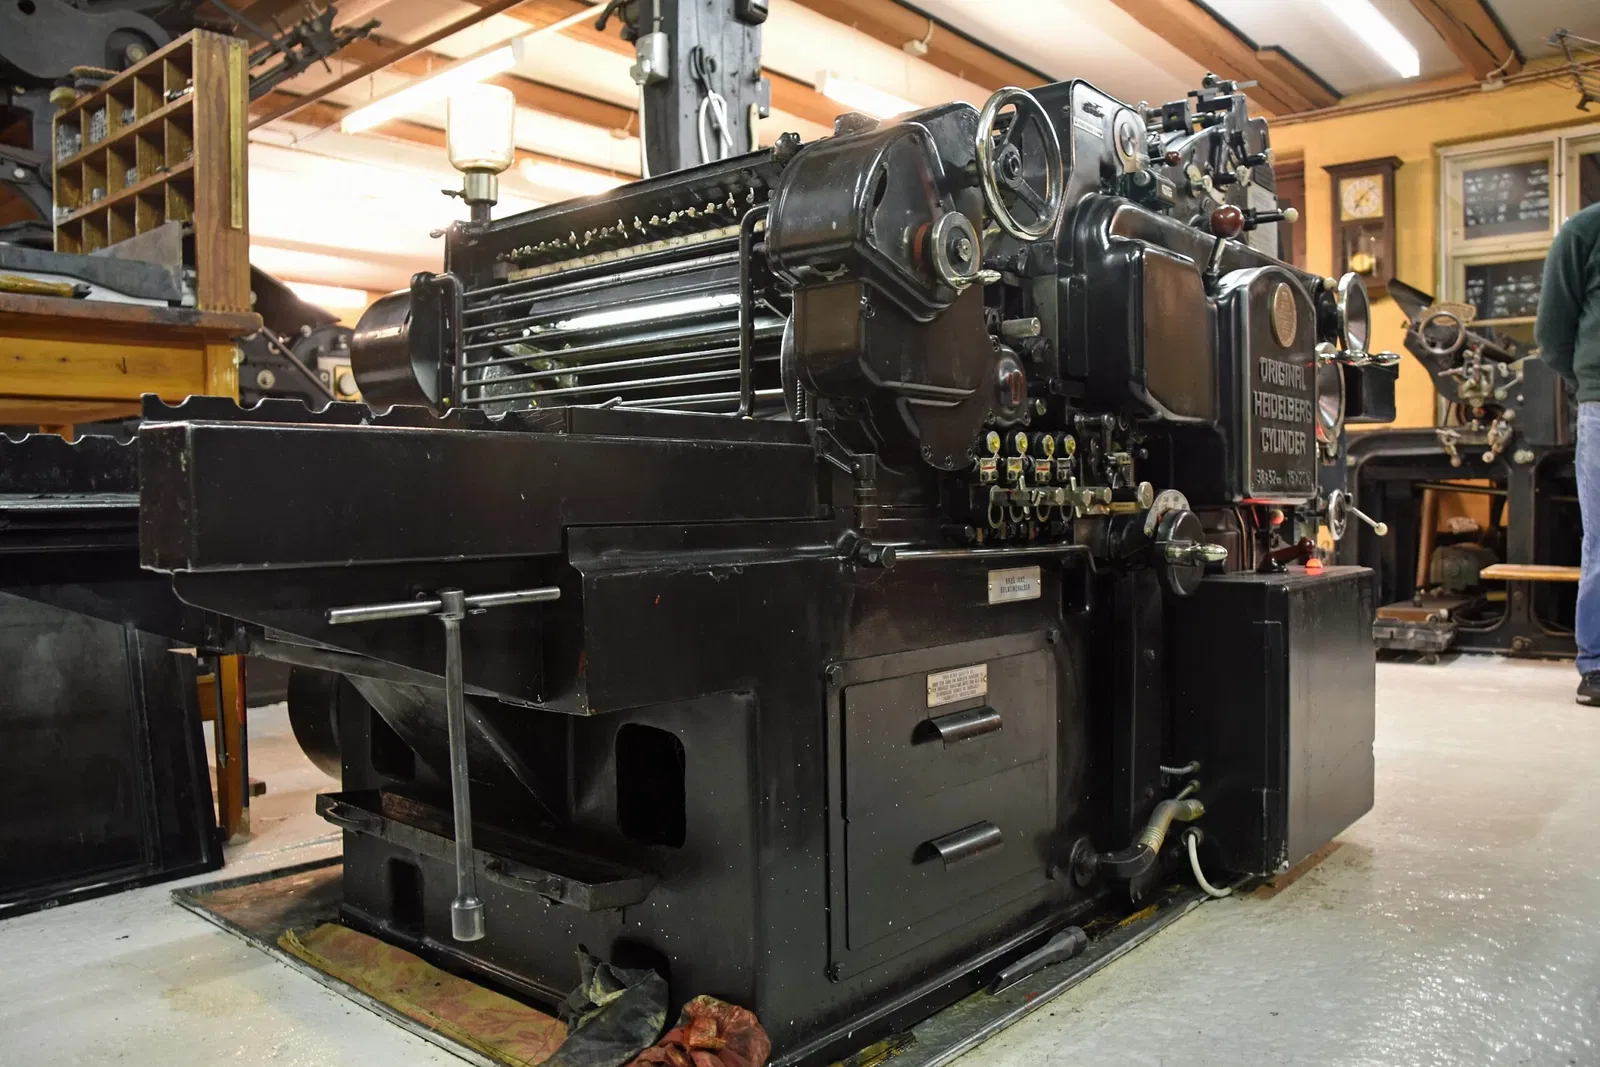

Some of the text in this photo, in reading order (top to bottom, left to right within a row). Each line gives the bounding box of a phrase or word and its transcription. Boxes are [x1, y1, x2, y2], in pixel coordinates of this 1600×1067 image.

[1259, 356, 1306, 390] ORIGINAL
[1254, 391, 1312, 424] HEIDELBERG
[1260, 428, 1307, 455] CYLINDER
